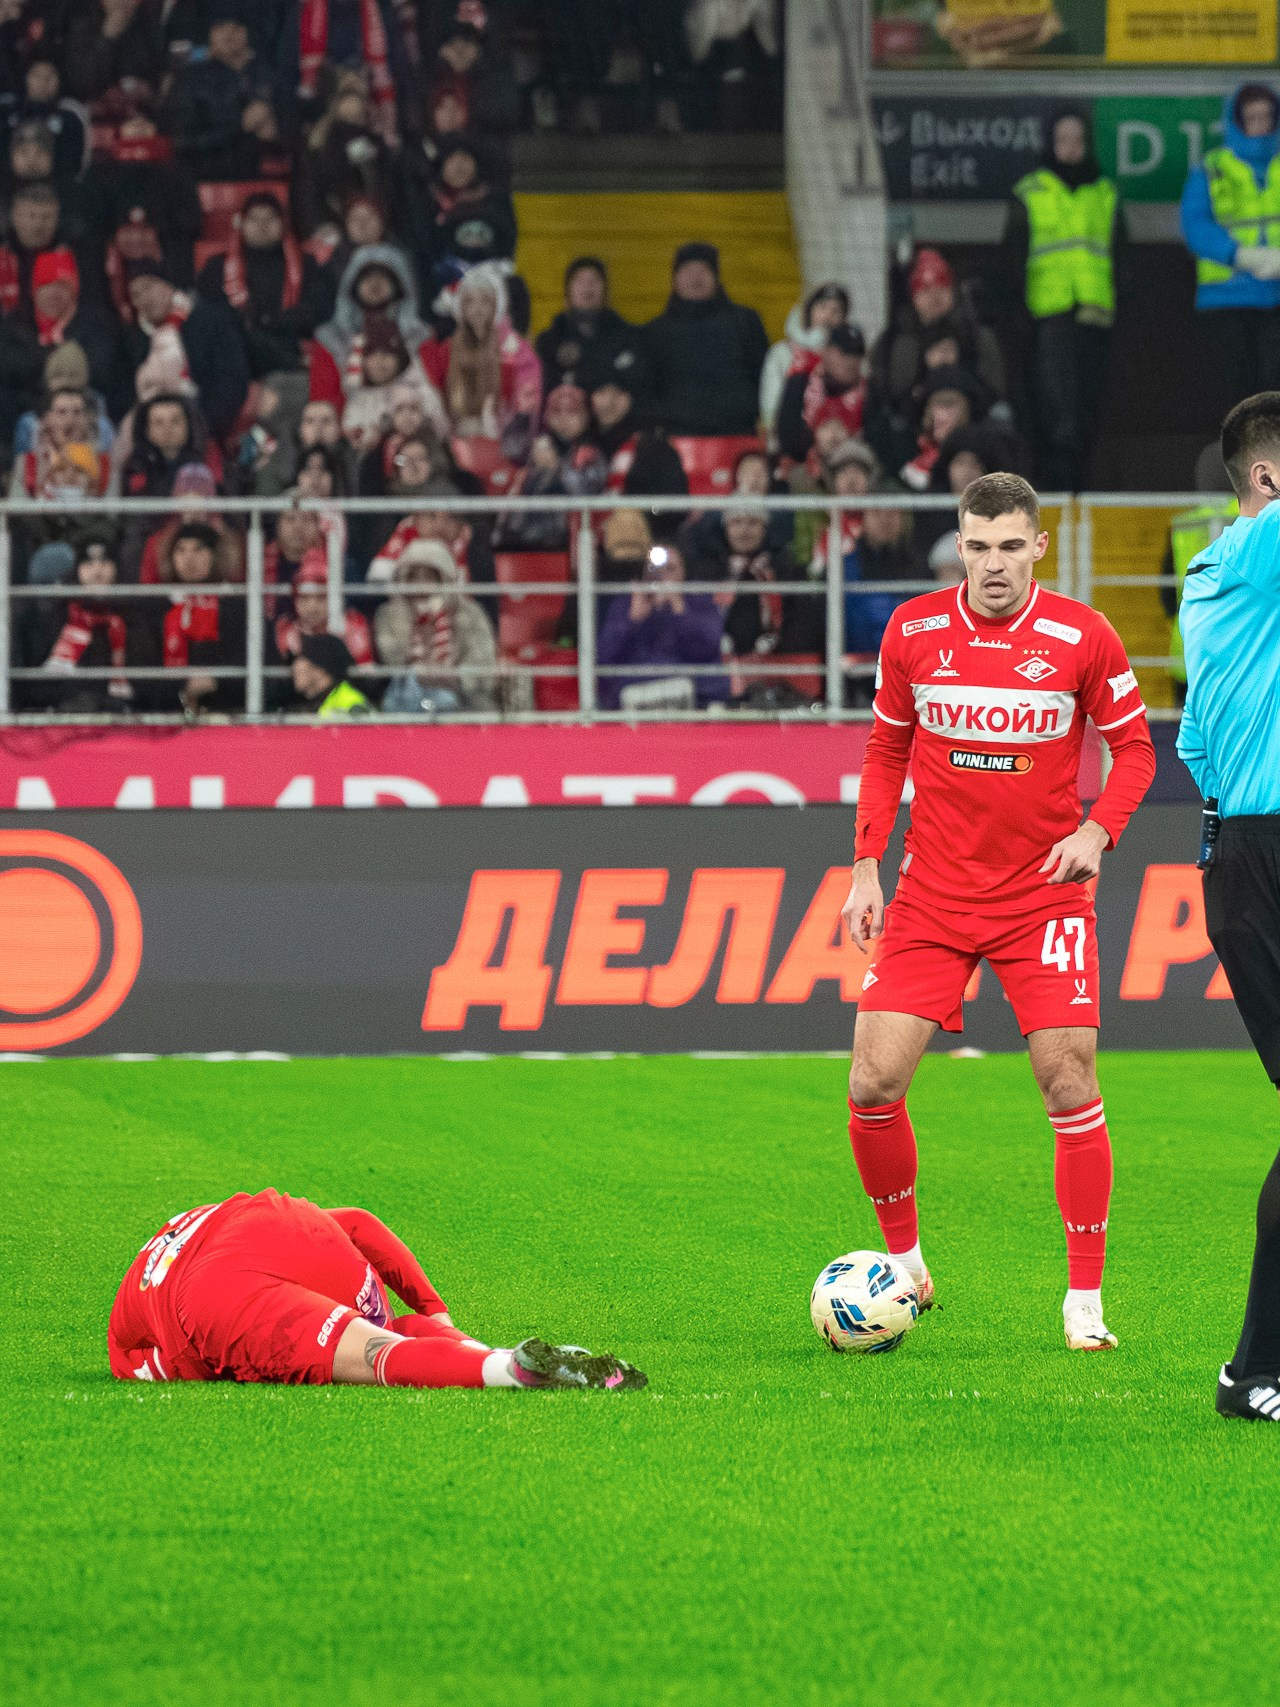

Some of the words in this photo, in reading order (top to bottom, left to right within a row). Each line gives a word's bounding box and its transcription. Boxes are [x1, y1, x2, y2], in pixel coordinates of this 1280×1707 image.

[911, 110, 1041, 150] Выход
[1116, 119, 1164, 176] D
[1178, 119, 1226, 169] 1
[911, 152, 979, 187] Exit
[927, 701, 1059, 733] ЛУКОЙЛ
[953, 753, 1013, 770] WINLINE
[420, 867, 1098, 1031] ДЕЛА
[1041, 917, 1087, 973] 47
